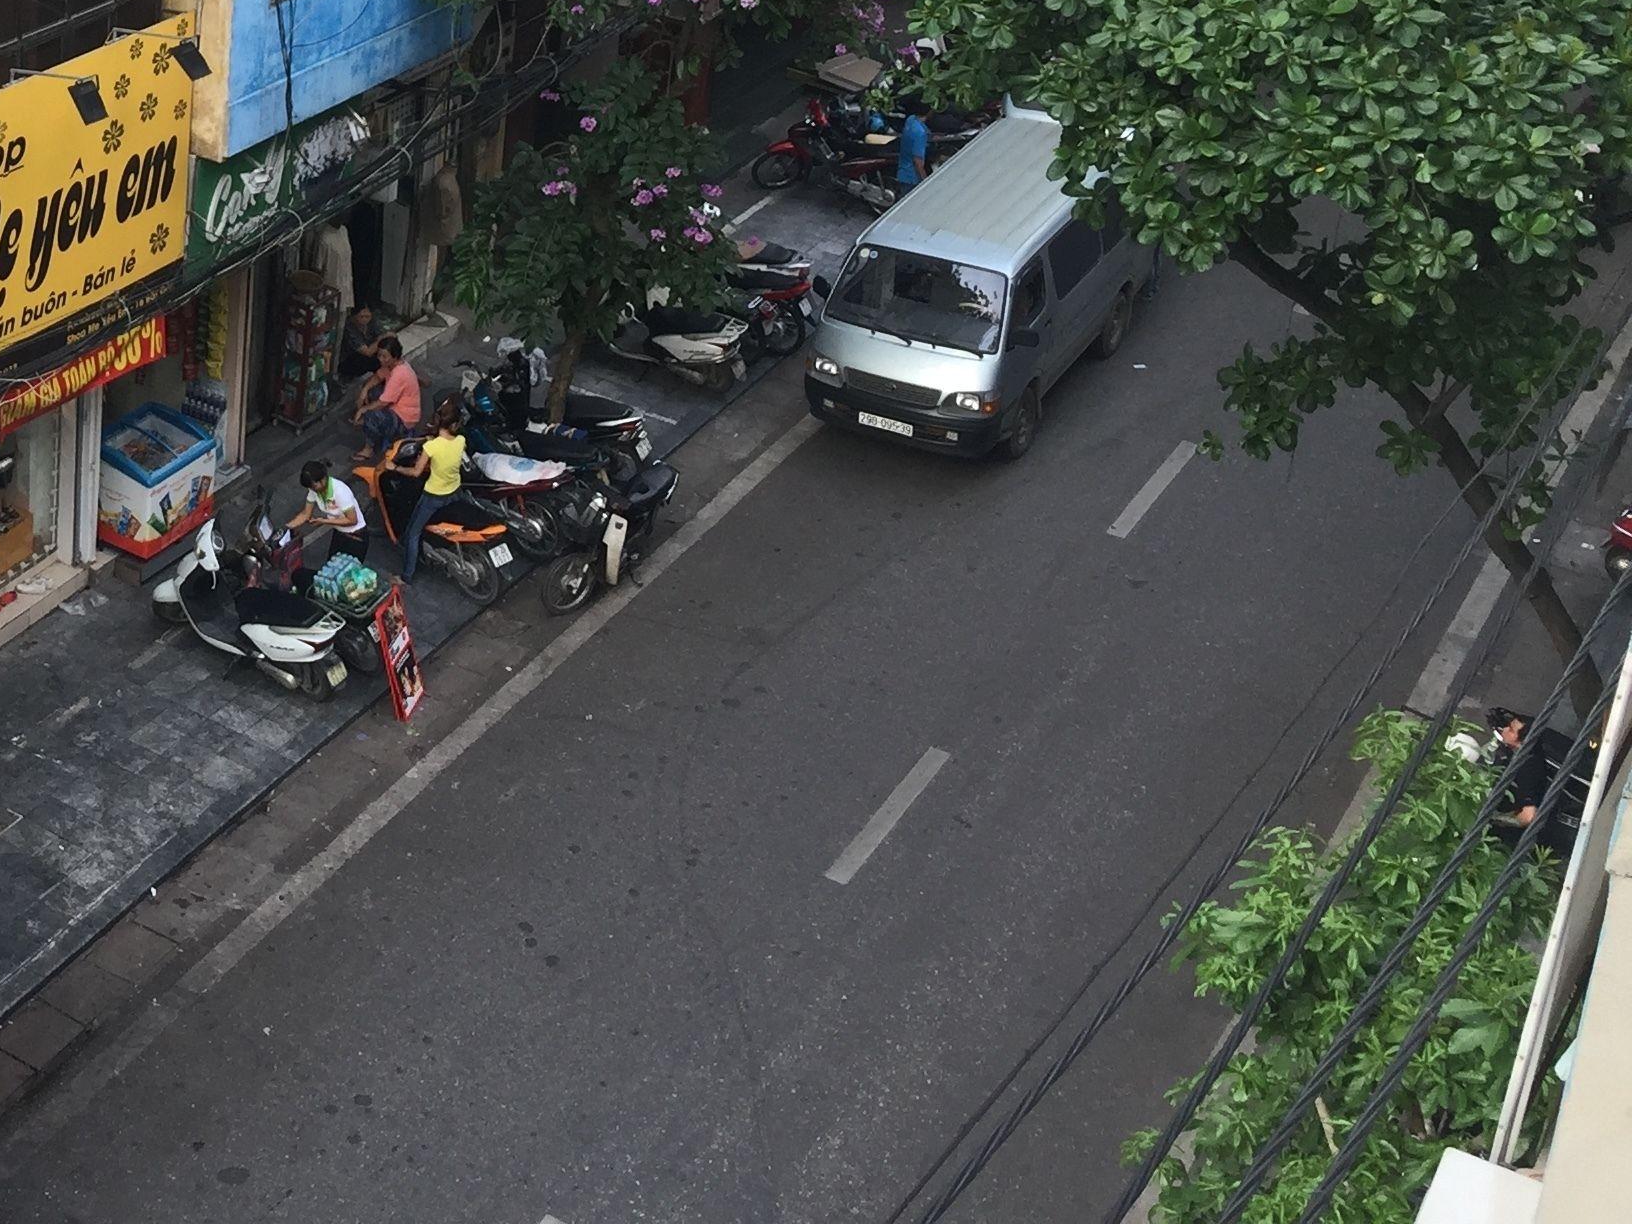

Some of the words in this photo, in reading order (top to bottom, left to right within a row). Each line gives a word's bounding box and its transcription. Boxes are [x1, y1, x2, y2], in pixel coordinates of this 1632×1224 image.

[24, 157, 108, 293] yêu
[115, 134, 178, 224] em
[20, 287, 67, 327] buôn
[82, 265, 116, 296] Bán
[120, 248, 137, 277] lẻ
[62, 356, 96, 395] TOÀN
